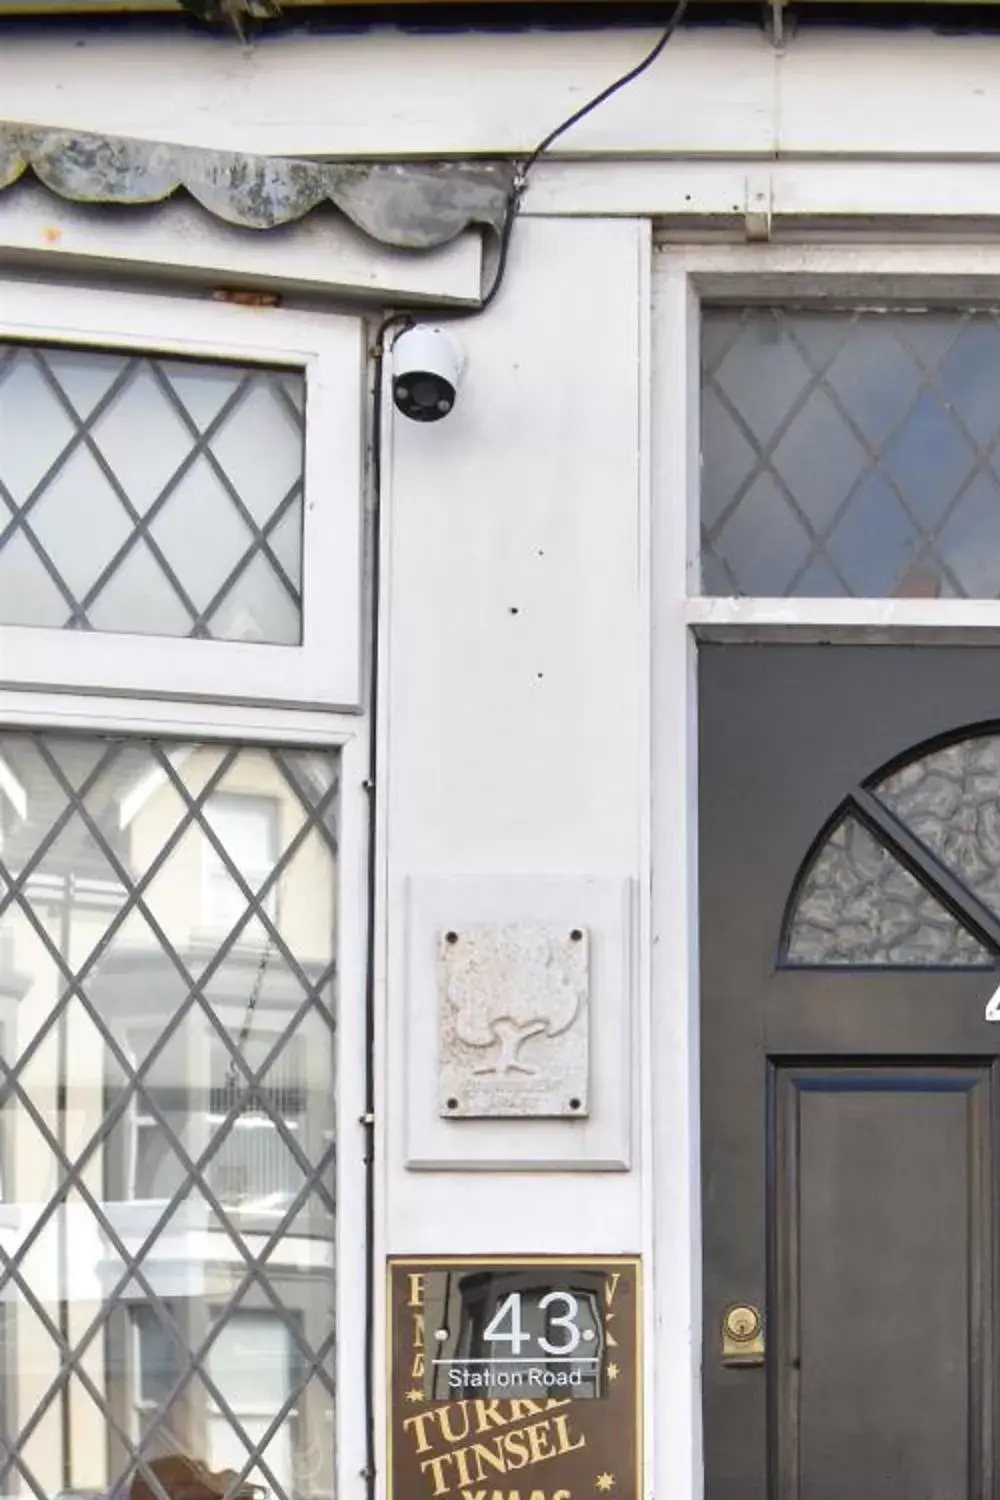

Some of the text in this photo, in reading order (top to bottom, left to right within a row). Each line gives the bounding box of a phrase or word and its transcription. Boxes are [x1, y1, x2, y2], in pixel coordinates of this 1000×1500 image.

[483, 1292, 580, 1355] 43
[448, 1367, 582, 1388] Station Road
[402, 1398, 573, 1454] TURK
[420, 1414, 586, 1496] TINSEL
